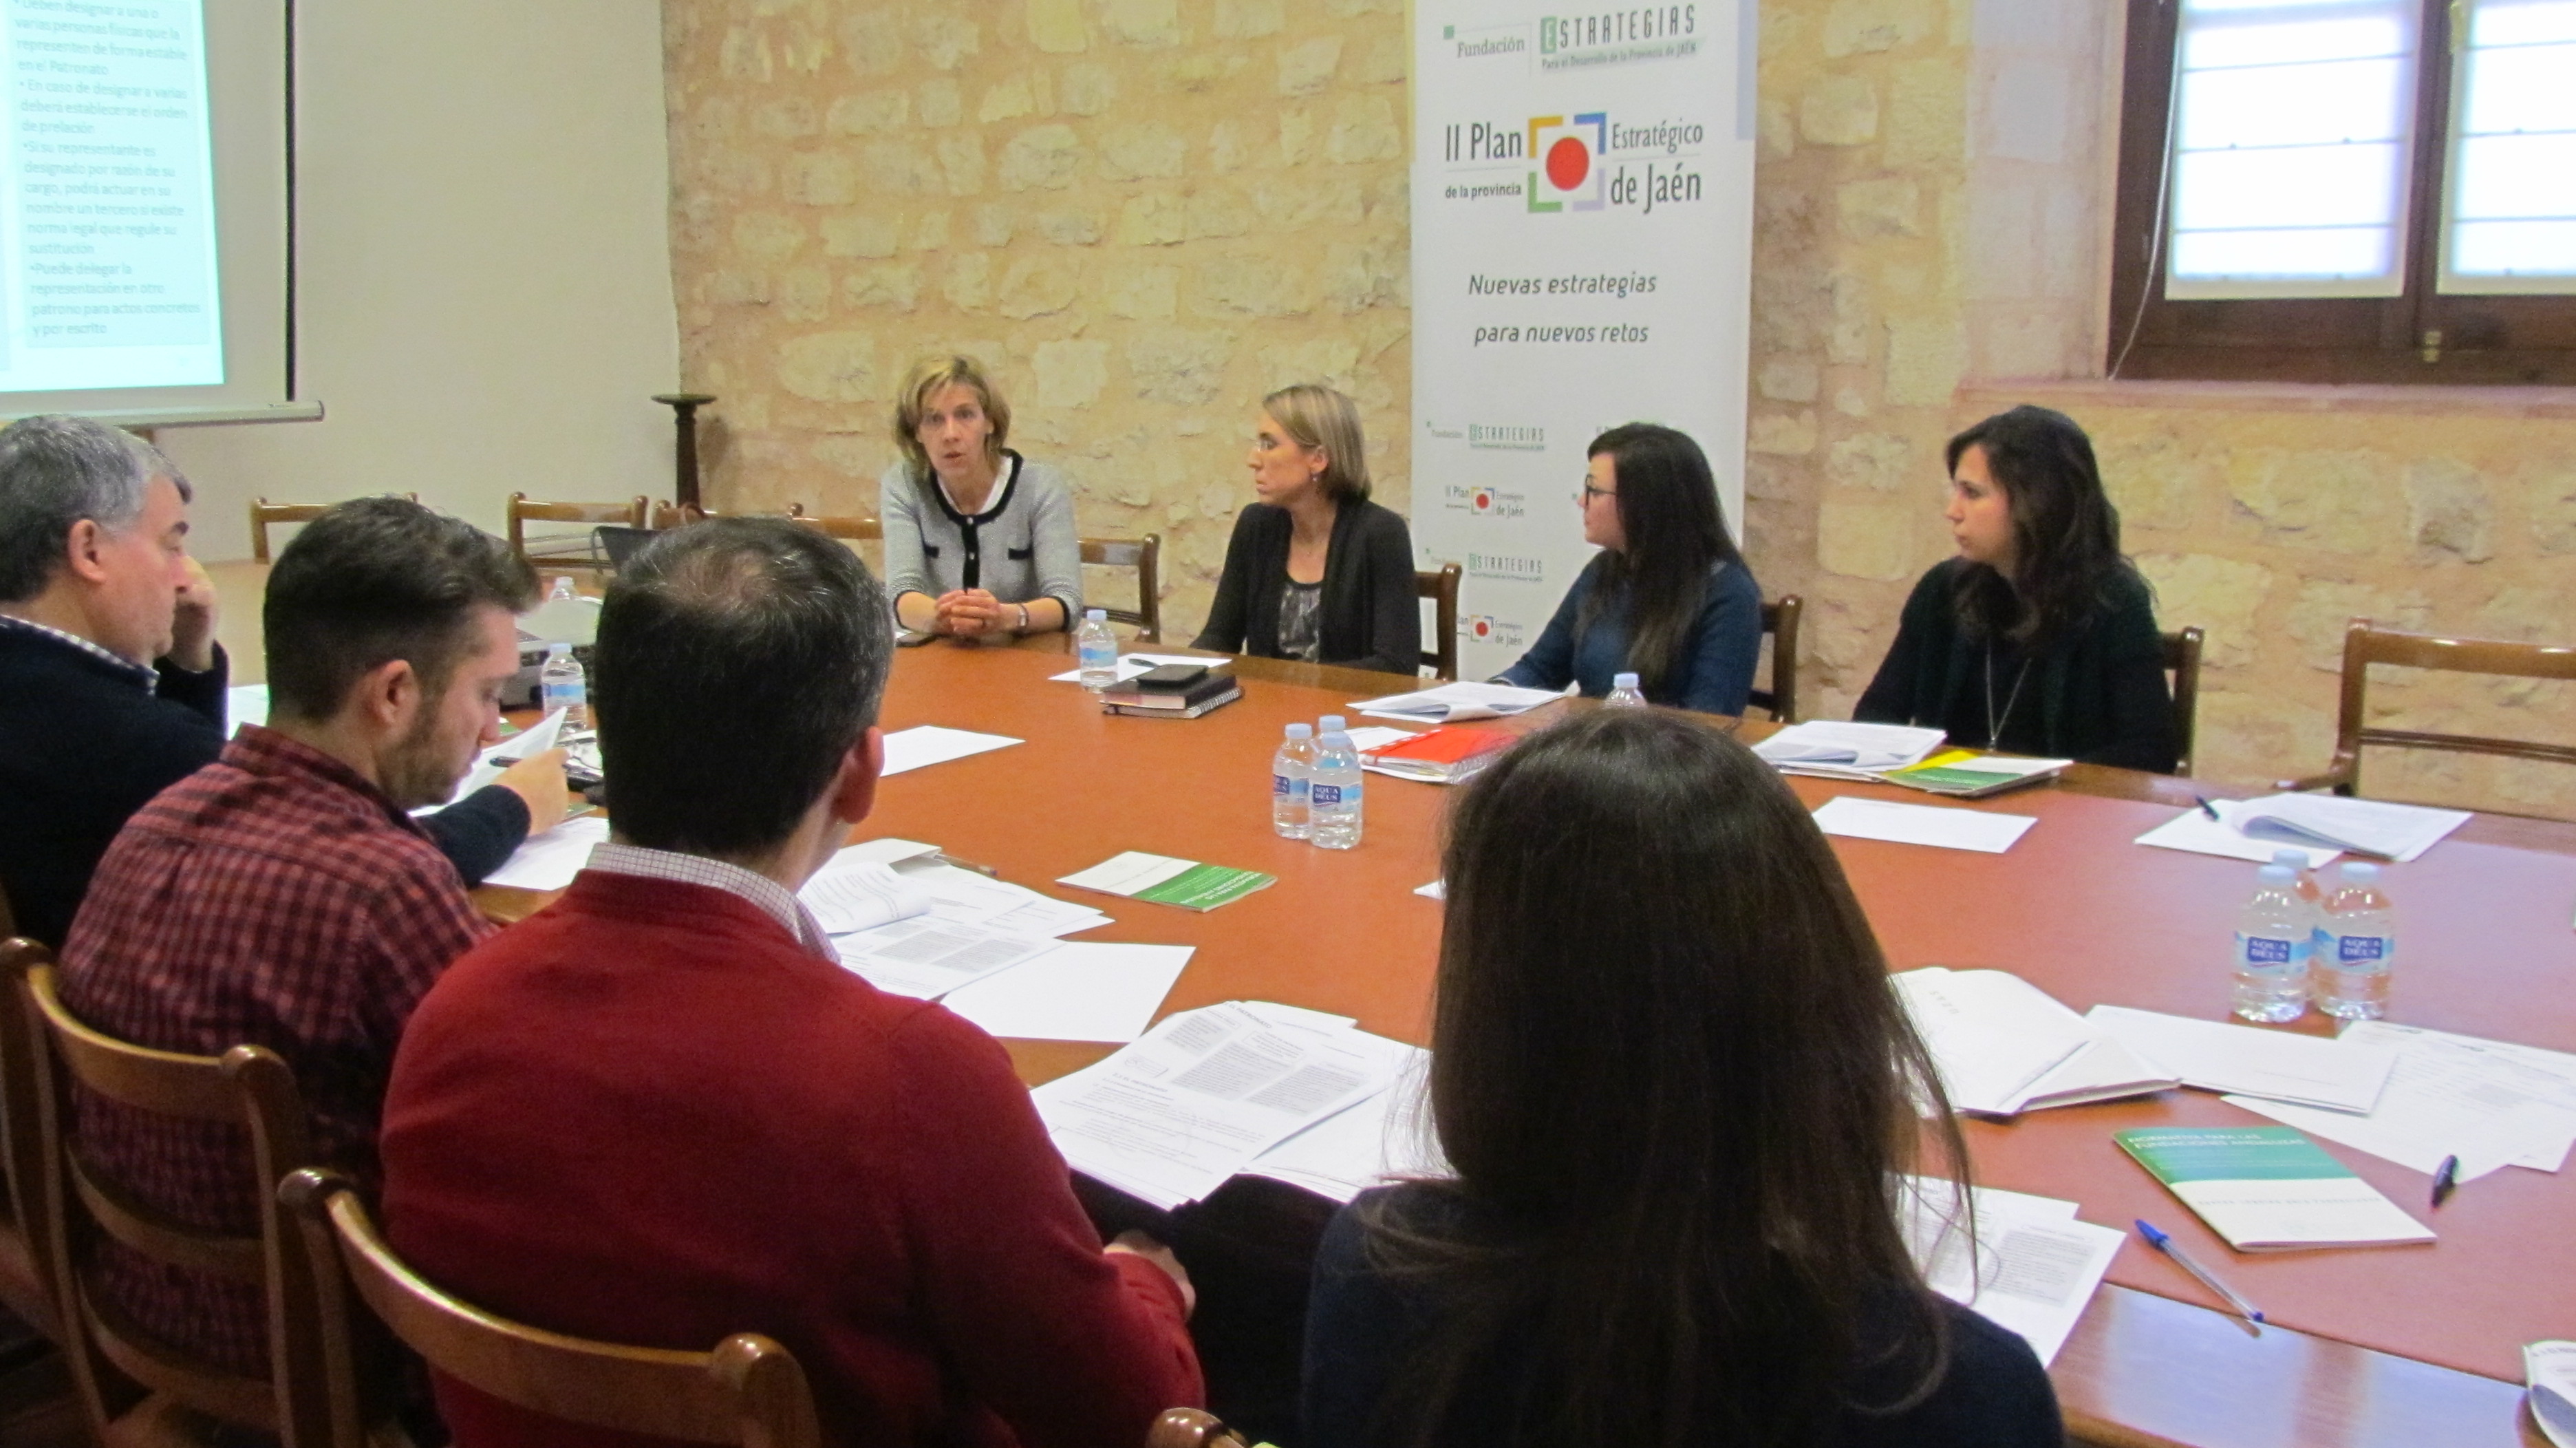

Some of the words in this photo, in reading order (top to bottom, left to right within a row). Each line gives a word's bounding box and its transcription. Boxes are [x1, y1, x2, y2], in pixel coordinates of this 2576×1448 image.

[65, 1, 114, 17] designar
[116, 8, 124, 17] a
[126, 10, 149, 19] una
[15, 19, 52, 31] varias
[53, 21, 107, 35] personas
[145, 30, 168, 41] que
[169, 26, 180, 40] la
[1457, 37, 1525, 58] Fundación
[1541, 3, 1695, 54] ESTRATEGIAS
[17, 39, 91, 54] representen
[92, 42, 107, 55] de
[109, 42, 144, 57] forma
[145, 46, 187, 60] estable
[17, 61, 34, 71] en
[36, 59, 45, 72] el
[50, 60, 109, 75] Patronato
[28, 78, 42, 91] En
[45, 83, 72, 93] caso
[75, 81, 91, 94] de
[92, 82, 142, 98] designar
[144, 88, 151, 97] a
[153, 87, 187, 99] varias
[65, 100, 139, 117] establecerse
[153, 105, 187, 118] orden
[22, 119, 37, 132] de
[1446, 124, 1460, 162] II
[1470, 121, 1522, 161] Plan
[1612, 117, 1704, 154] Estratégico
[27, 140, 40, 152] Si
[41, 143, 54, 153] su
[56, 143, 141, 157] representante
[142, 147, 156, 158] es
[24, 160, 86, 177] designado
[88, 164, 108, 178] por
[145, 163, 161, 177] de
[162, 167, 175, 178] su
[101, 184, 138, 195] actuar
[140, 187, 155, 196] en
[158, 187, 171, 196] su
[1445, 185, 1457, 199] de
[1459, 184, 1469, 198] la
[1470, 183, 1522, 201] provincia
[1611, 165, 1638, 205] de
[1642, 162, 1702, 215] Jaén
[25, 201, 74, 214] nombre
[77, 205, 92, 214] un
[95, 204, 138, 215] tercero
[151, 204, 184, 216] existe
[27, 224, 67, 234] norma
[69, 222, 97, 237] legal
[99, 224, 121, 237] que
[125, 222, 161, 237] regule
[164, 226, 177, 236] su
[34, 262, 74, 275] Puede
[75, 262, 119, 278] delegar
[121, 261, 132, 275] la
[122, 284, 137, 294] en
[139, 282, 165, 294] otro
[1468, 274, 1542, 295] Nuevas
[1547, 270, 1657, 299] estrategias
[31, 304, 82, 318] patrono
[83, 304, 110, 317] para
[111, 303, 143, 314] actos
[144, 301, 201, 314] concretos
[32, 326, 40, 338] y
[42, 324, 63, 337] por
[67, 322, 107, 334] escrito
[1474, 326, 1520, 348] para
[1525, 326, 1596, 343] nuevos
[1600, 323, 1649, 343] retos
[1469, 424, 1545, 442] ESTRATEGIAS
[1452, 485, 1470, 498] Plan
[1496, 505, 1506, 515] de
[1507, 504, 1525, 520] Jaén
[1469, 553, 1543, 573] ESTRATEGIAS
[1457, 613, 1470, 625] lan
[1495, 635, 1505, 644] de
[1505, 635, 1523, 648] Jaén
